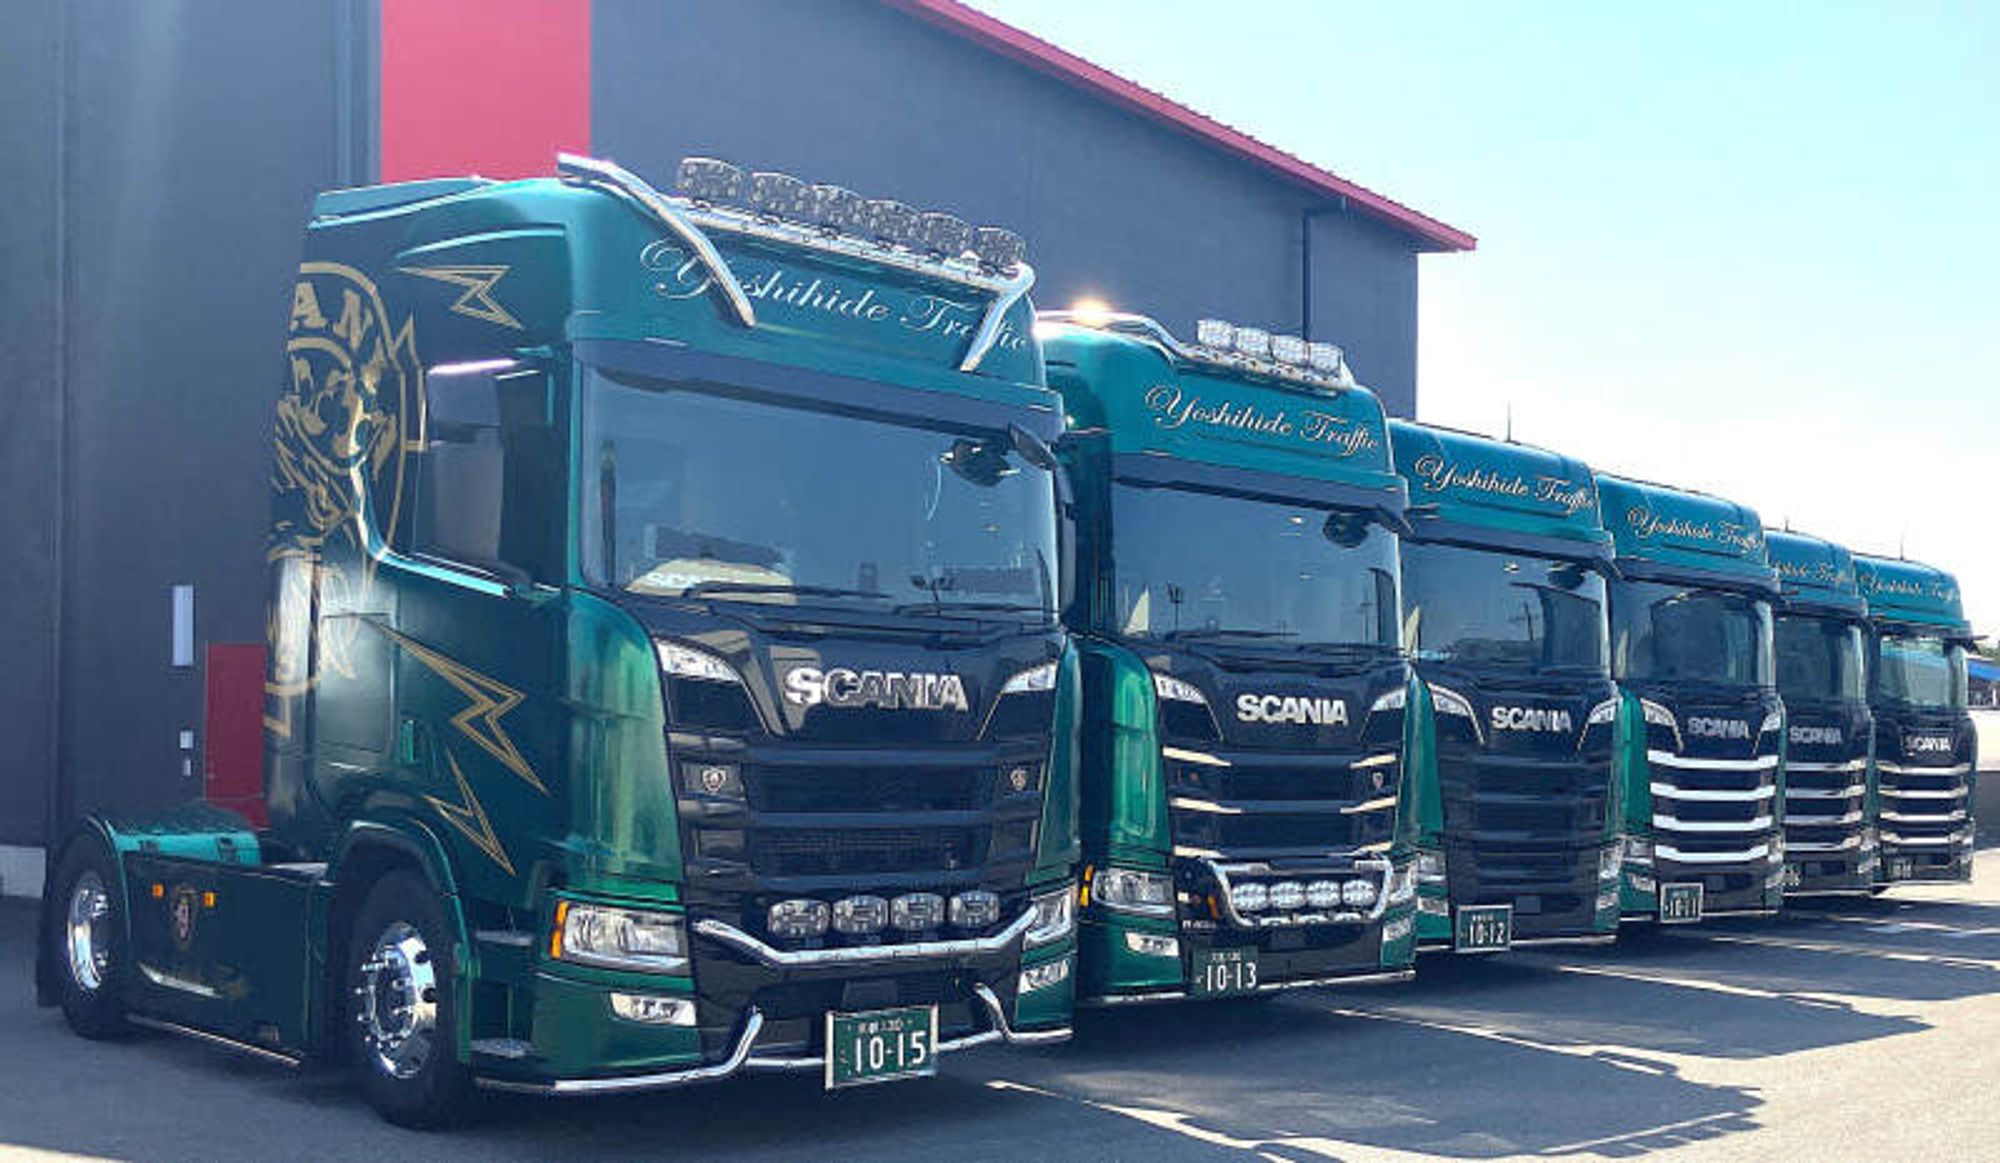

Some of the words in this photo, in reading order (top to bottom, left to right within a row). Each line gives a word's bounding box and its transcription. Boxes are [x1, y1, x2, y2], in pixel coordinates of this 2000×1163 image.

[640, 237, 889, 322] Yshihide
[1145, 383, 1293, 434] Yoshihide
[1300, 410, 1379, 457] Traffic
[784, 666, 969, 711] SCANIA
[1237, 694, 1348, 727] SCANIA
[1491, 706, 1573, 734] SCANIA
